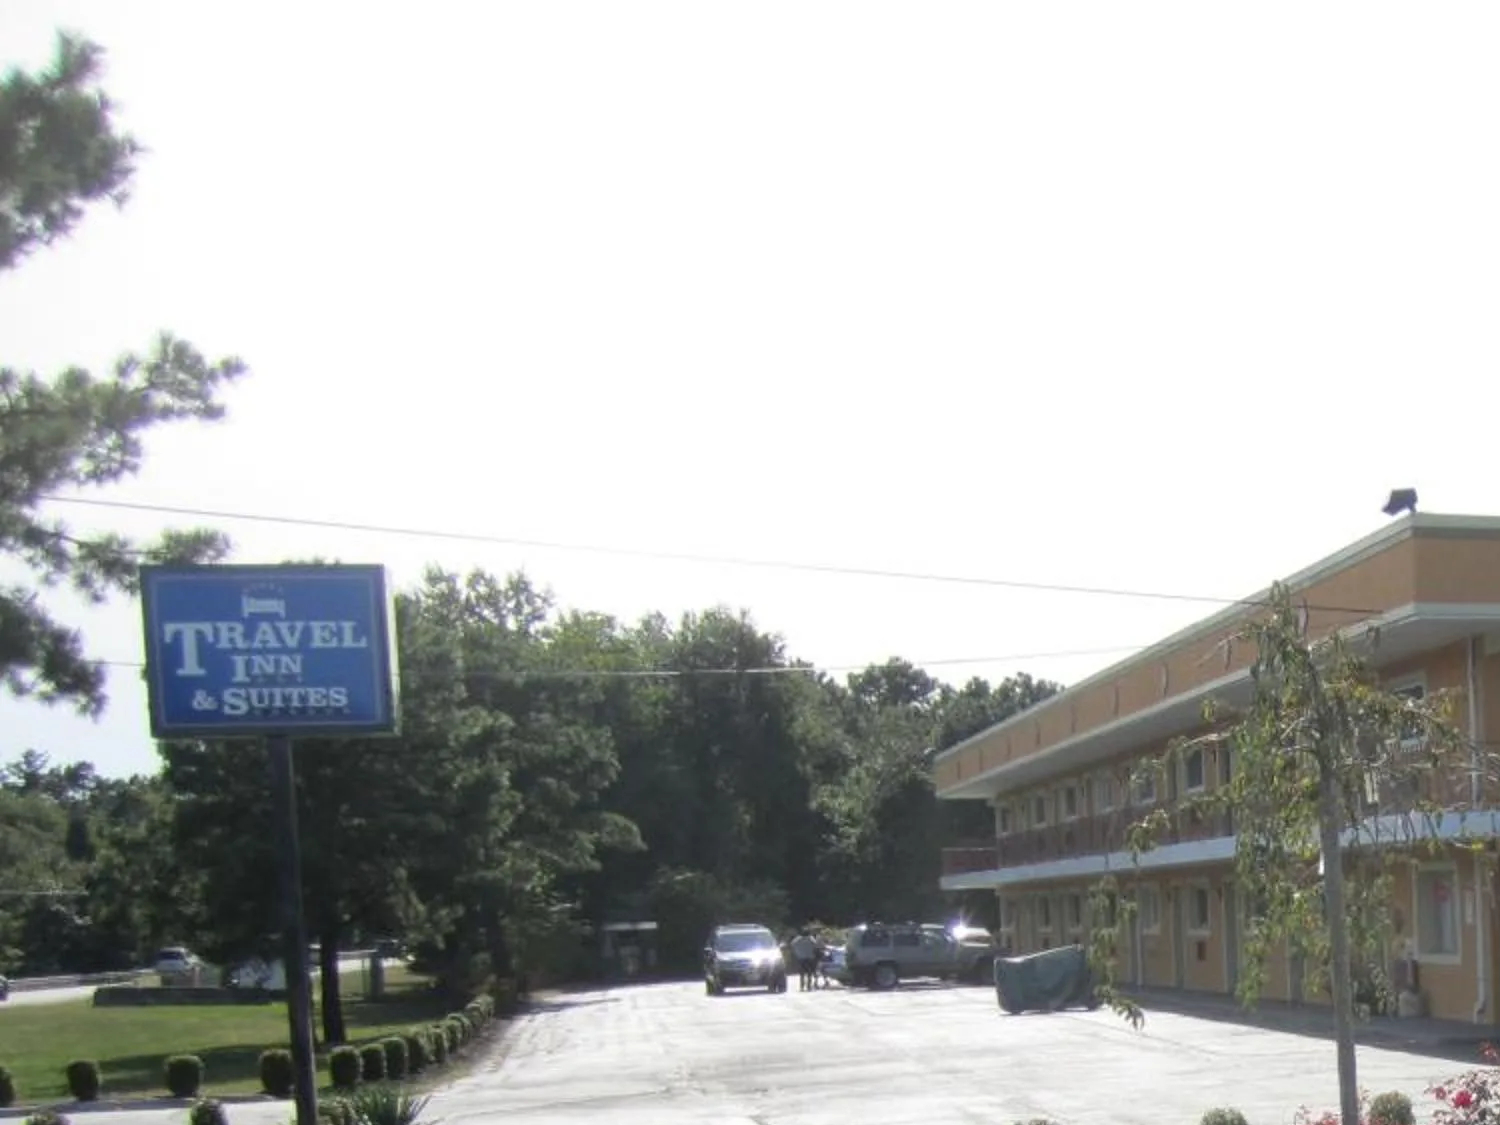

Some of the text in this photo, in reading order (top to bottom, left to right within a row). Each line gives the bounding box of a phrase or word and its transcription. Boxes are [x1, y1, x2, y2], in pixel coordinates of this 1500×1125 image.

[163, 620, 368, 678] TRAVEL
[229, 654, 304, 684] INN
[222, 686, 349, 716] SUITES
